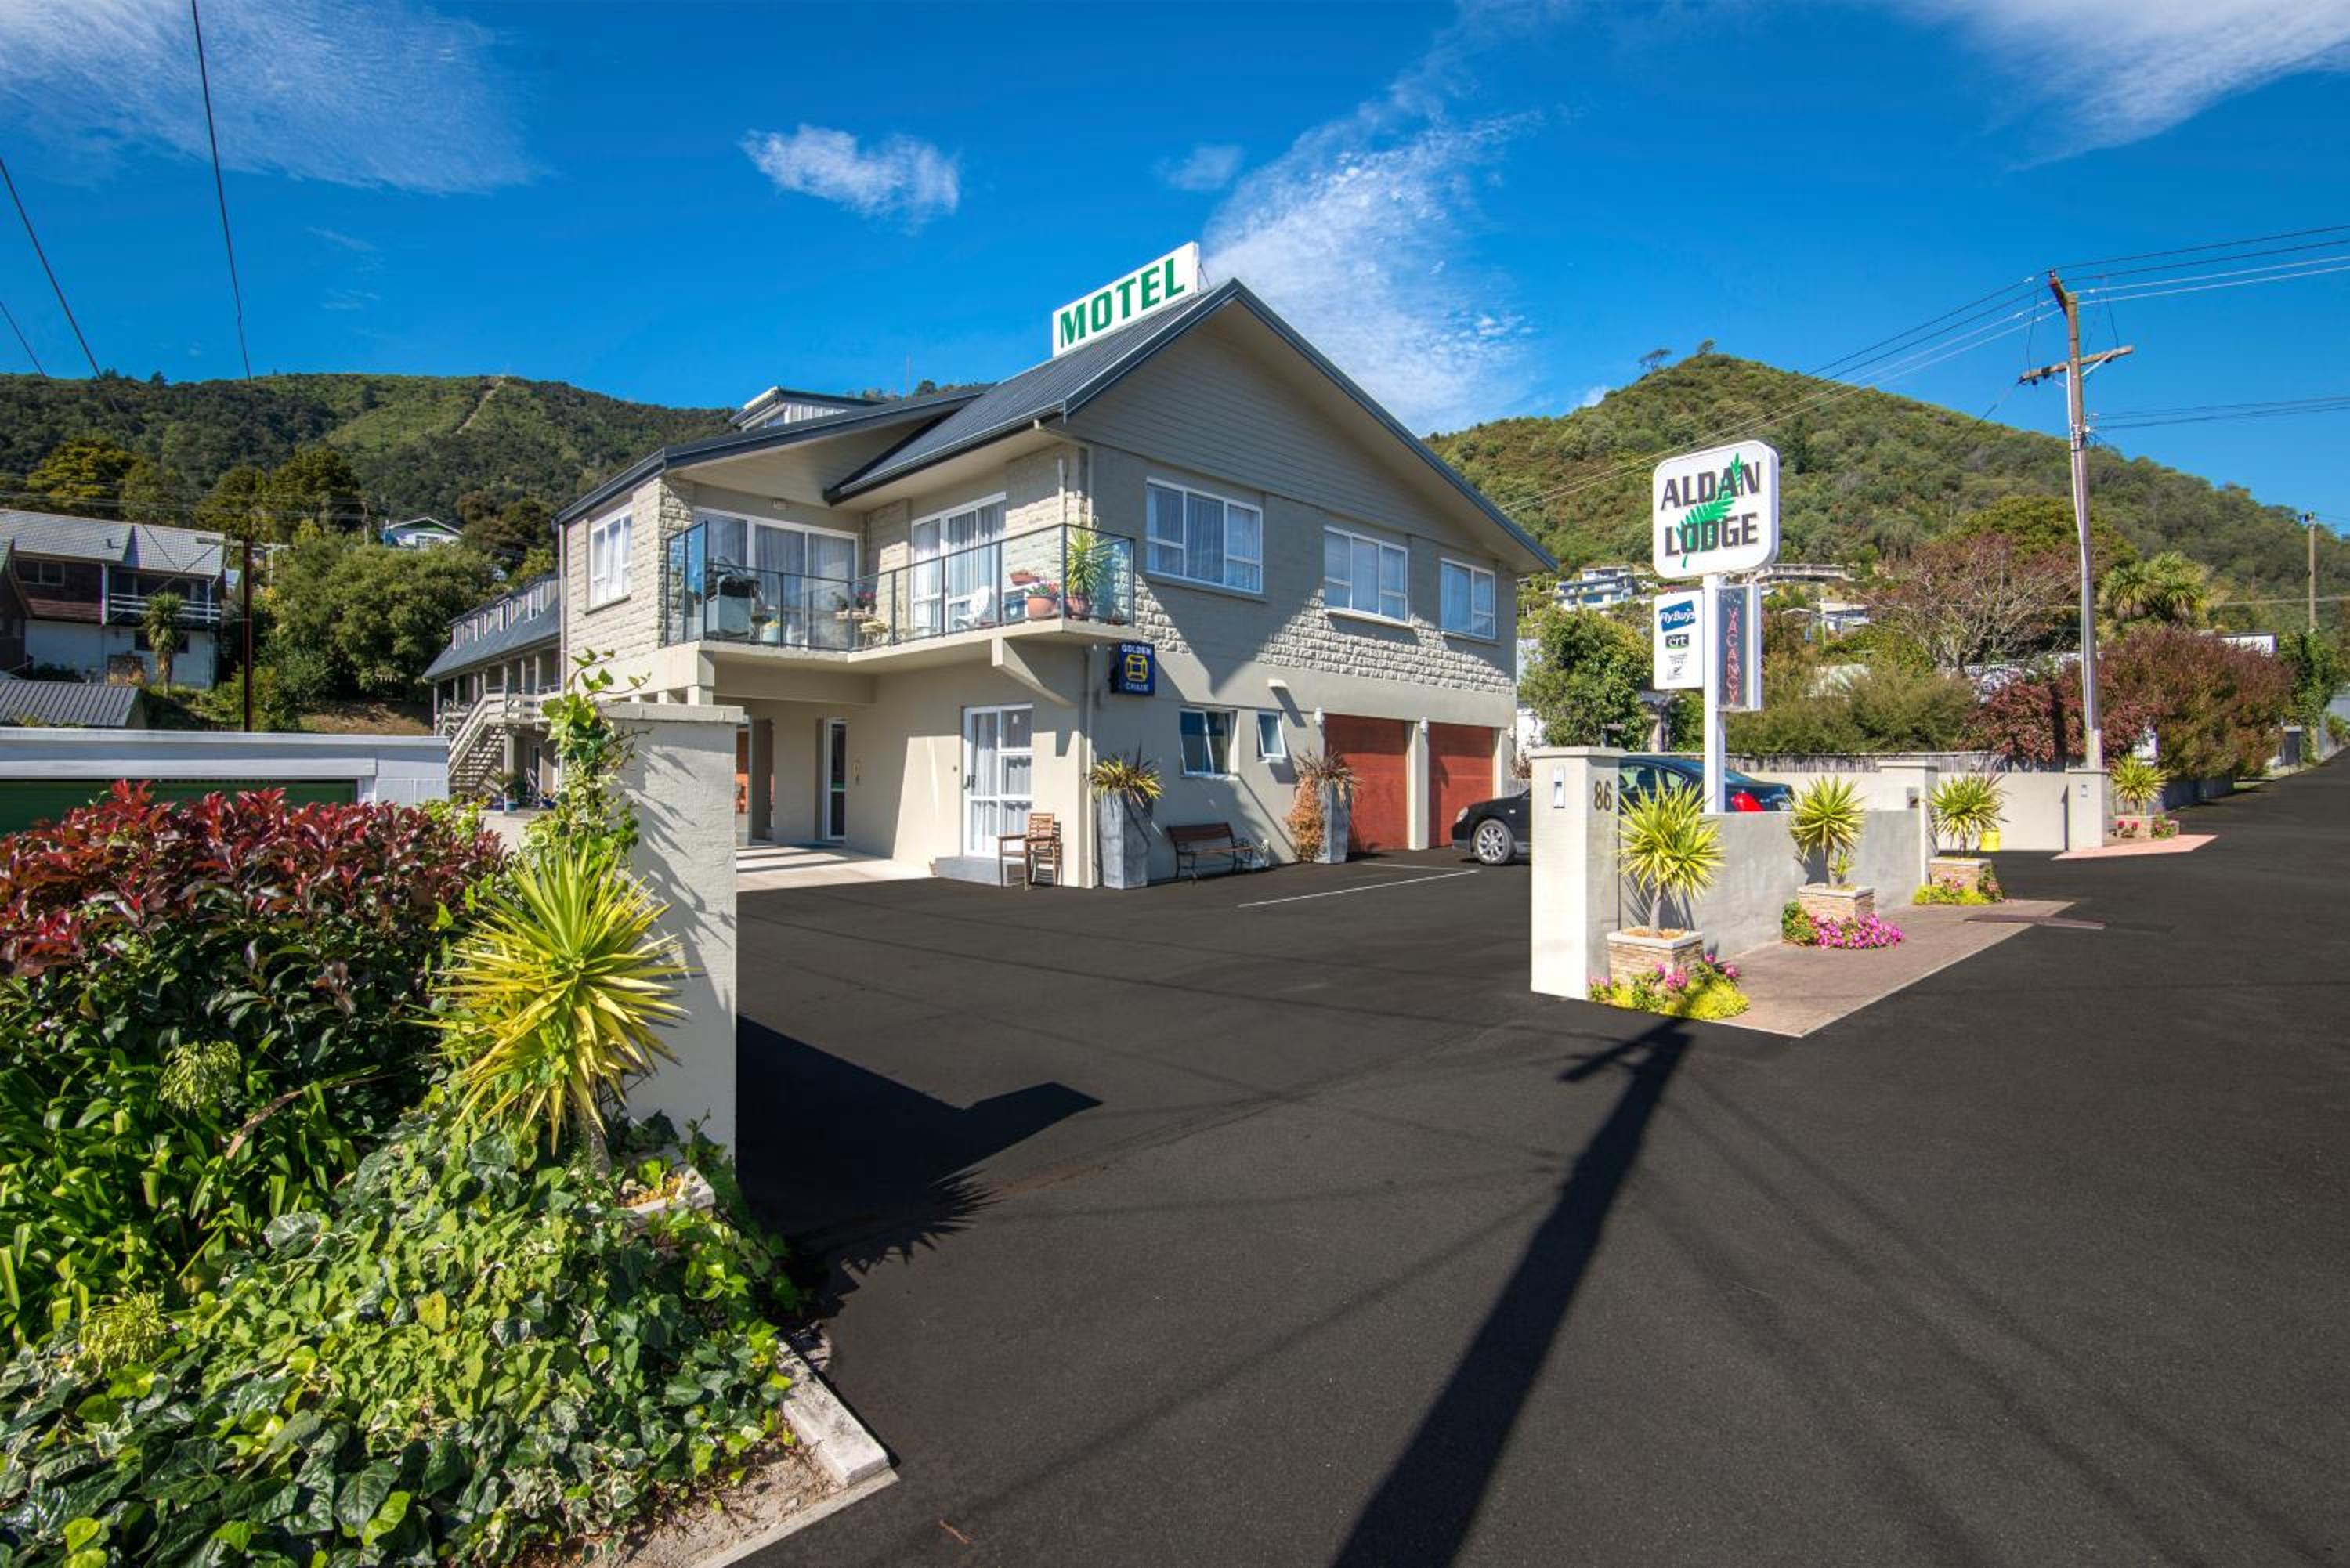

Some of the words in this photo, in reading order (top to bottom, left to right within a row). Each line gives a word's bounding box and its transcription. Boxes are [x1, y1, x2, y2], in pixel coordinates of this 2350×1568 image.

[1060, 258, 1185, 349] MOTEL
[1661, 461, 1760, 511] ALDAN
[1665, 512, 1759, 557] LODGE
[1121, 644, 1153, 654] GOLDEN
[1726, 606, 1740, 703] VACANCY
[1594, 780, 1612, 811] 86
